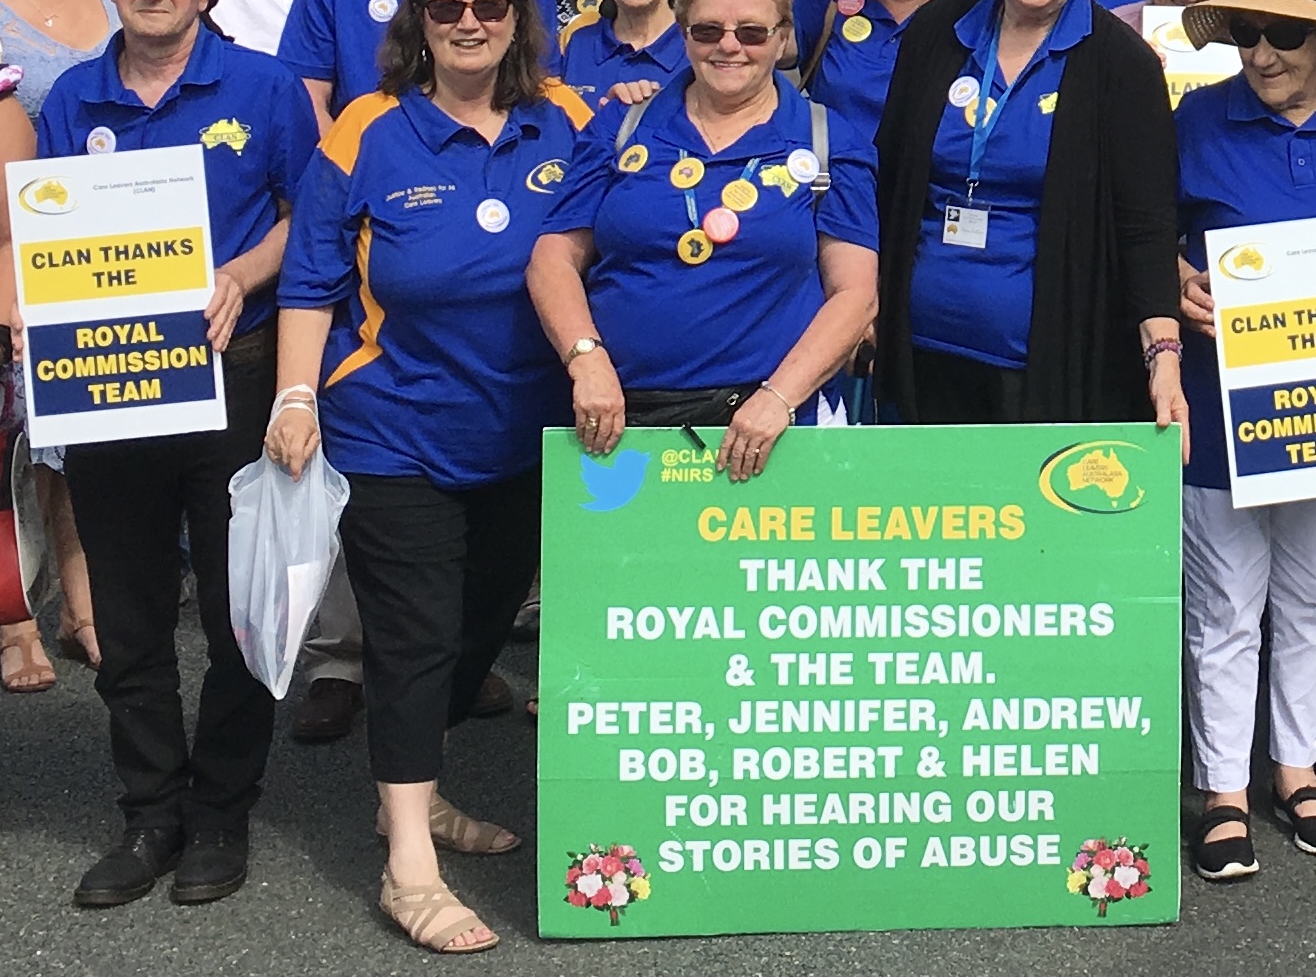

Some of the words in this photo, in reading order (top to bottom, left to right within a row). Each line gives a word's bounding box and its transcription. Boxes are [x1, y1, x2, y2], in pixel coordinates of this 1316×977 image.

[31, 248, 92, 270] CLAN
[99, 238, 194, 263] THANKS
[92, 269, 137, 288] THE
[75, 322, 165, 349] ROYAL
[1231, 312, 1286, 334] CLAN
[37, 345, 208, 382] COMMISSION
[87, 378, 162, 405] TEAM
[660, 467, 714, 483] #NIRS
[661, 449, 719, 467] @CLA
[697, 505, 816, 542] CARE
[831, 504, 1026, 541] LEAVERS
[739, 558, 887, 592] THANK
[900, 558, 984, 591] THE
[606, 606, 746, 640] ROYAL
[757, 603, 1116, 640] COMMISSIONERS
[725, 655, 756, 687] &
[771, 654, 854, 687] THE
[868, 651, 997, 686] TEAM.
[567, 702, 716, 740] PETER,
[727, 699, 950, 739] JENNIFER,
[962, 697, 1152, 736] ANDREW,
[618, 749, 719, 788] BOB,
[732, 747, 904, 782] ROBERT
[917, 746, 947, 779] &
[962, 743, 1099, 778] HELEN
[664, 795, 749, 827] FOR
[762, 791, 952, 826] HEARING
[965, 790, 1055, 823] OUR
[658, 839, 841, 875] STORIES
[852, 837, 908, 871] OF
[920, 834, 1062, 868] ABUSE
